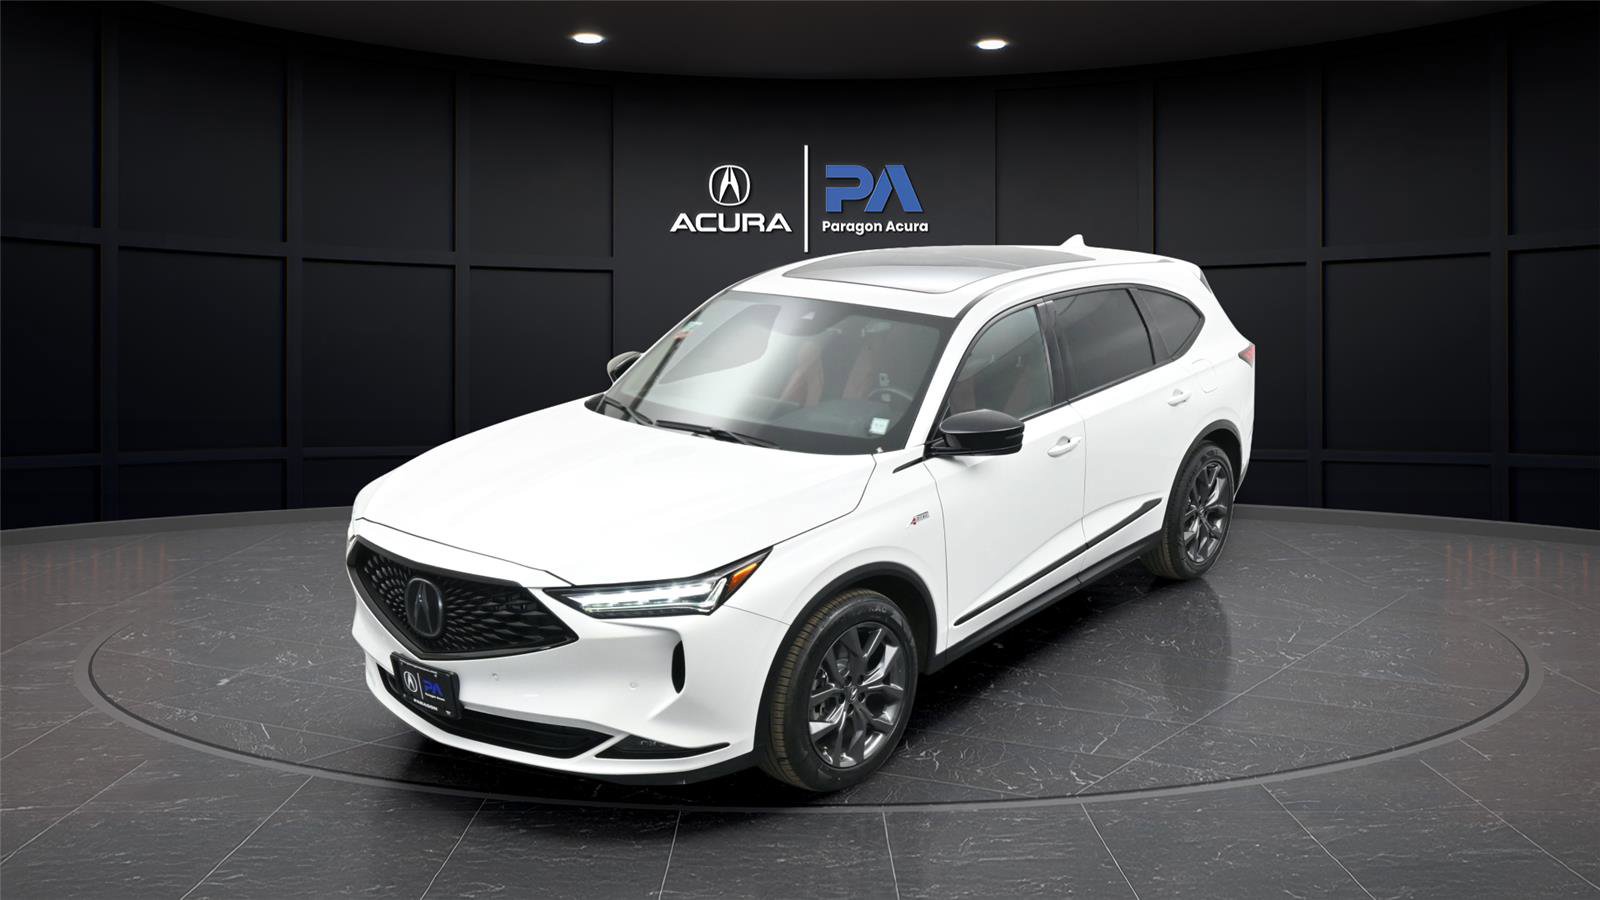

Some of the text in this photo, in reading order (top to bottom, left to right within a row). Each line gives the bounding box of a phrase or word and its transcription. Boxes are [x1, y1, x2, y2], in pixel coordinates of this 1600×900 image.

[826, 164, 923, 212] PA
[670, 213, 792, 232] ACURA
[822, 221, 929, 235] Paragon Acura
